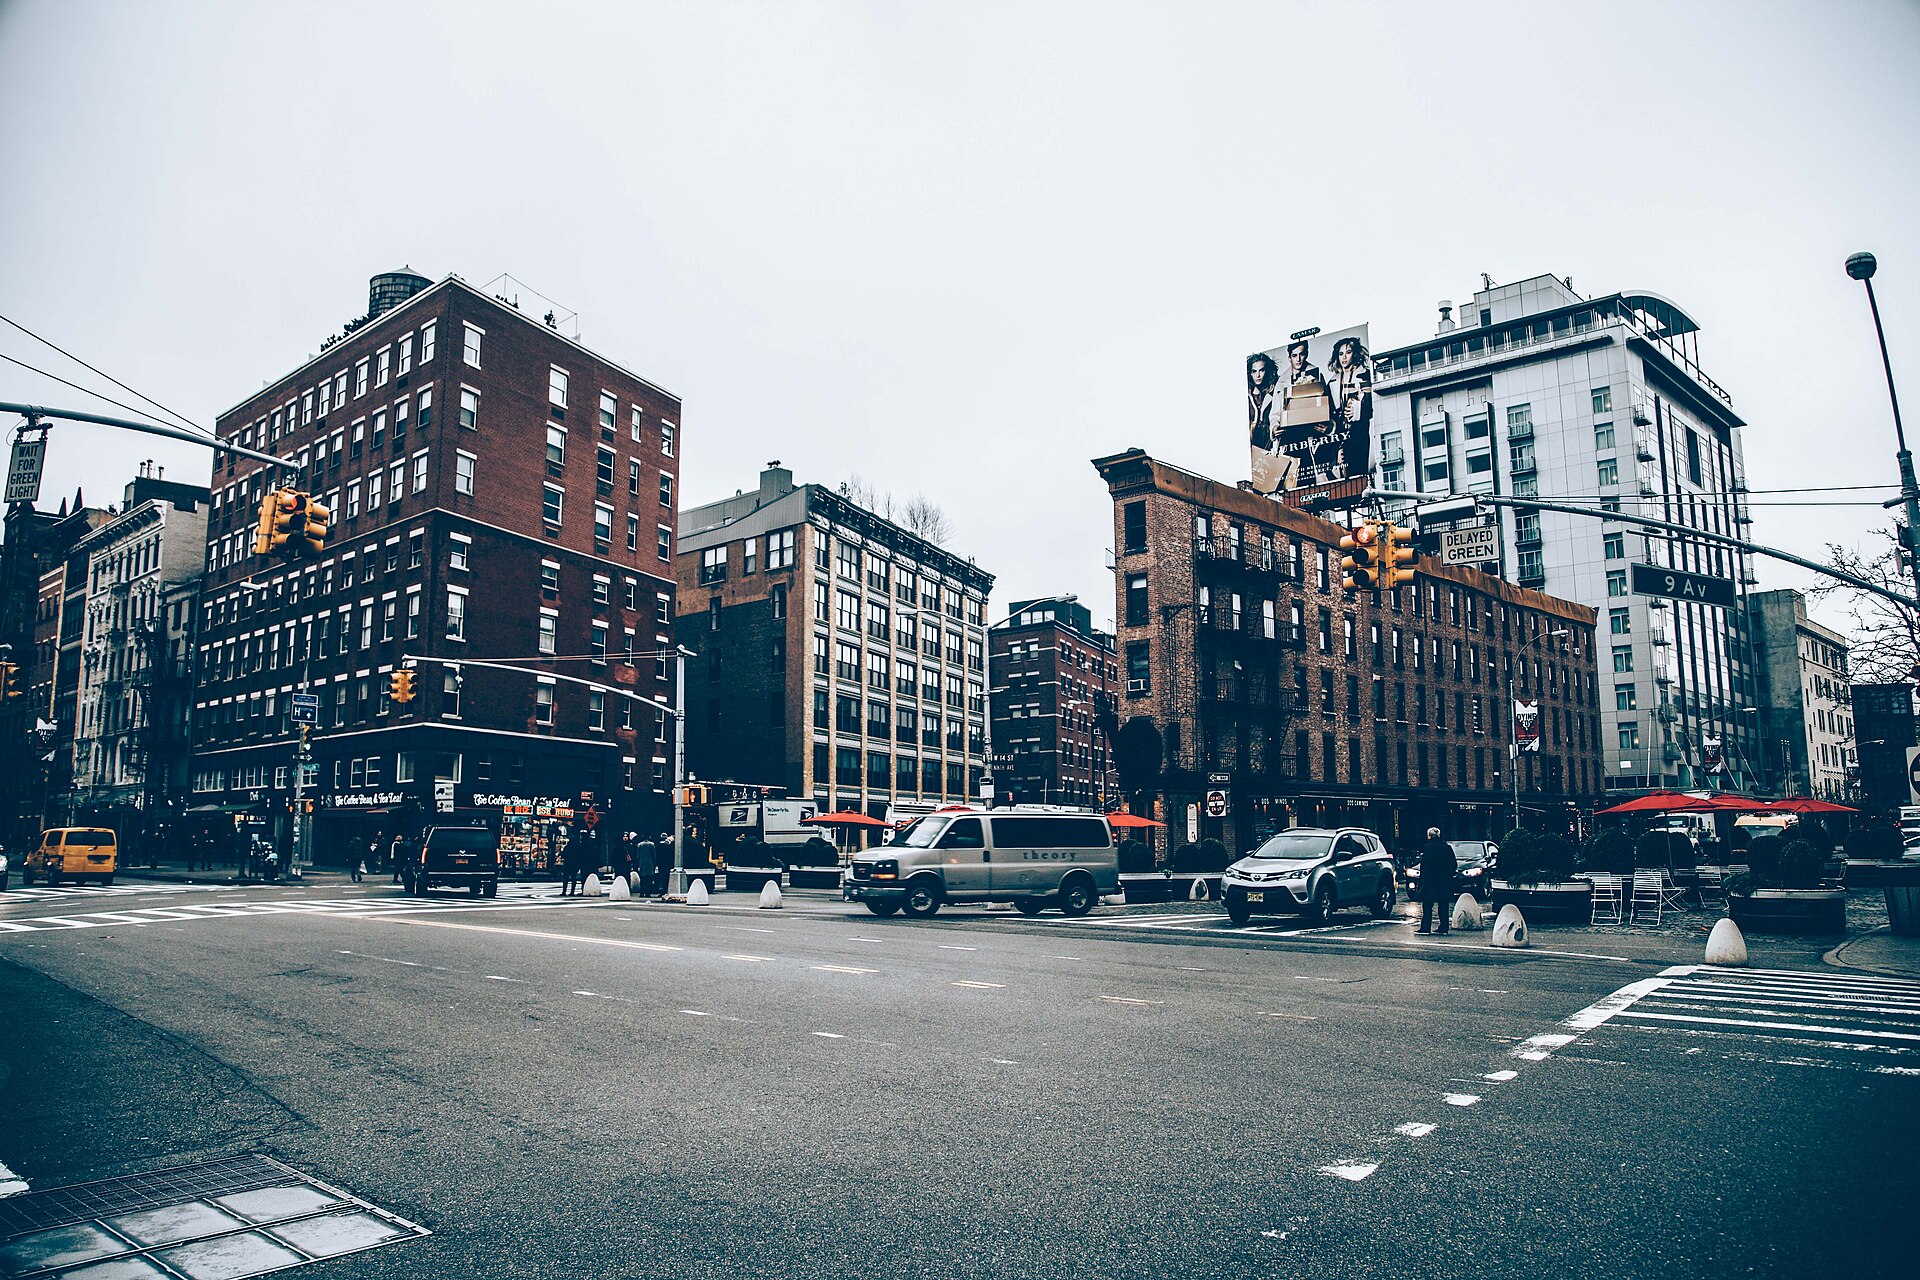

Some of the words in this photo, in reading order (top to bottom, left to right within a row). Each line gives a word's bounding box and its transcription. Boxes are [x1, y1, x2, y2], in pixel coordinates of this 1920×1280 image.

[1276, 430, 1350, 454] URBERRY
[19, 445, 39, 457] WAIT
[18, 459, 35, 471] FOR
[10, 472, 38, 485] GREEN
[9, 486, 35, 498] LIGHT
[1447, 530, 1493, 547] DELAYED
[1448, 544, 1493, 560] GREEN
[1664, 575, 1675, 592] 9
[1682, 578, 1706, 597] Av
[294, 706, 300, 716] H
[335, 795, 344, 806] The
[343, 794, 359, 805] Coffee
[358, 793, 373, 805] Bean
[388, 791, 404, 803] Leaf
[474, 794, 487, 806] The
[488, 795, 511, 805] Coffee
[510, 795, 531, 806] Bean
[553, 798, 571, 807] Leaf
[1023, 850, 1077, 861] theory
